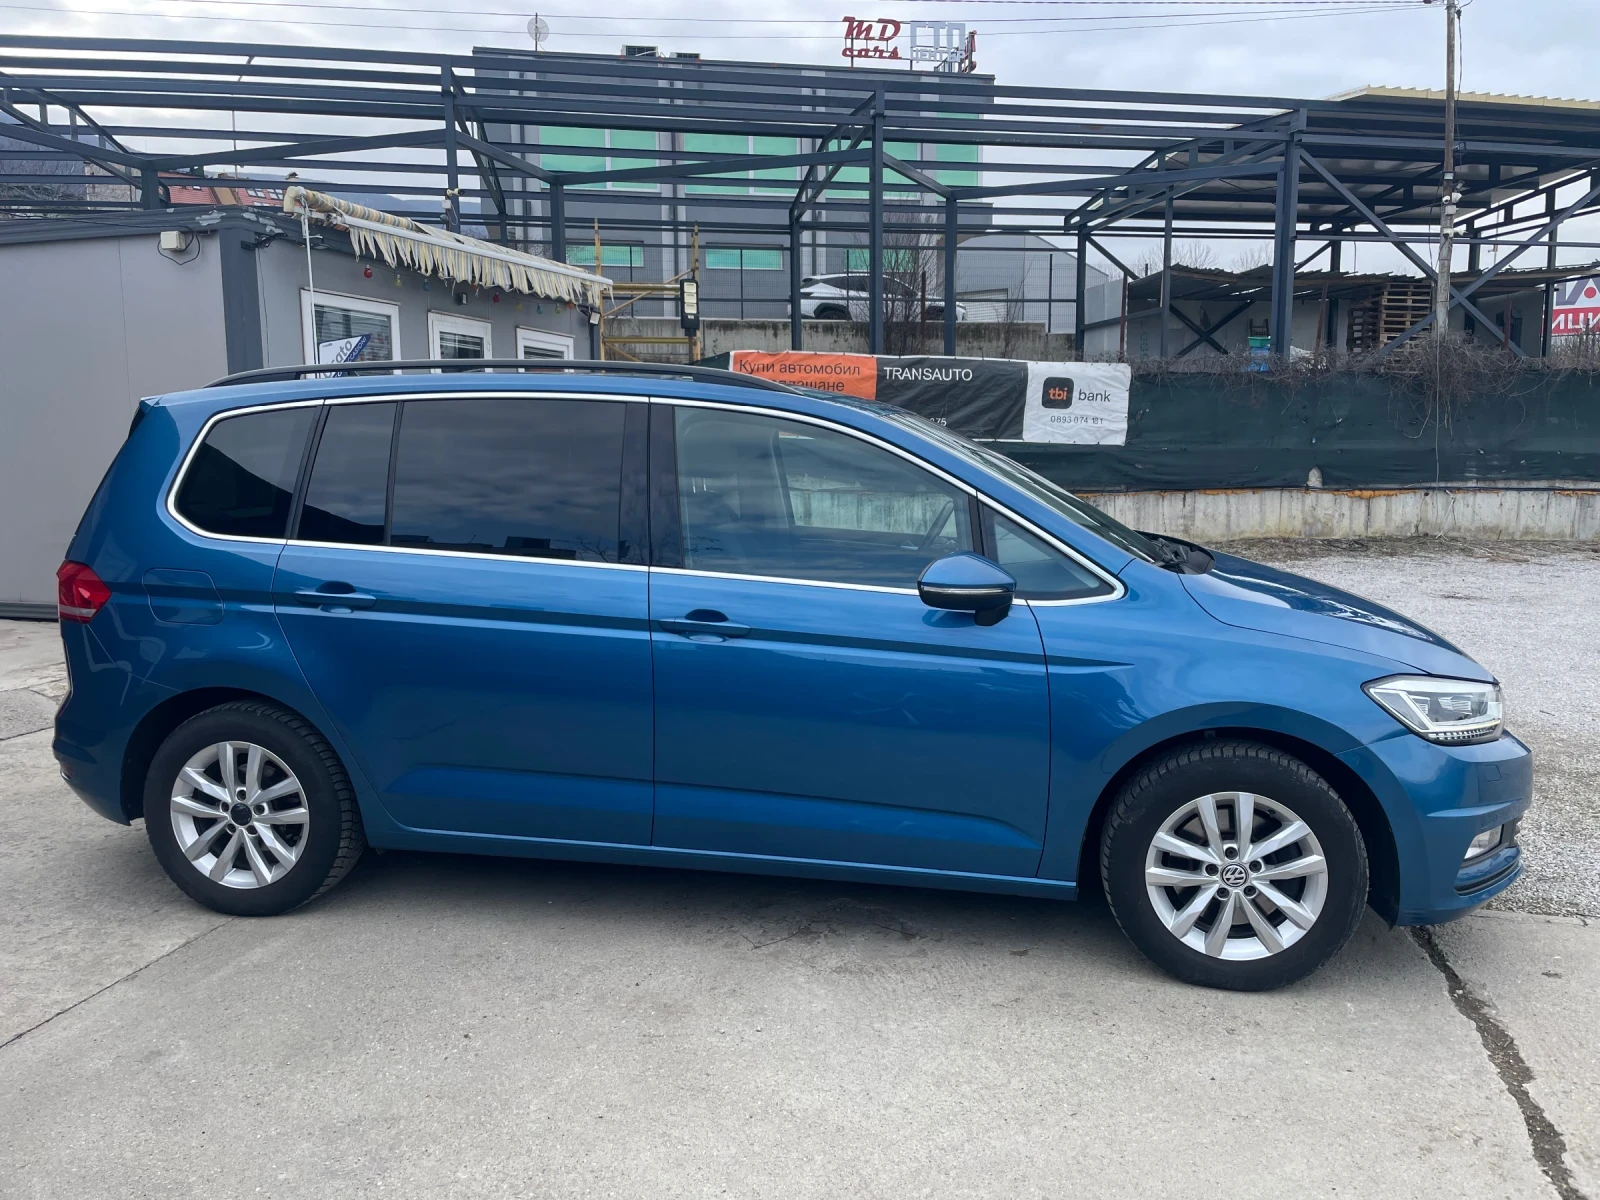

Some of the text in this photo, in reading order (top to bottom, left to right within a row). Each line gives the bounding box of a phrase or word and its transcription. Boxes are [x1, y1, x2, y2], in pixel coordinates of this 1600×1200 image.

[842, 46, 903, 60] cars
[739, 359, 860, 376] Купи автомобил
[883, 366, 973, 381] TRANSAUTO
[1048, 386, 1111, 402] tbi bank
[1050, 415, 1072, 424] 0893
[1073, 416, 1088, 424] 074
